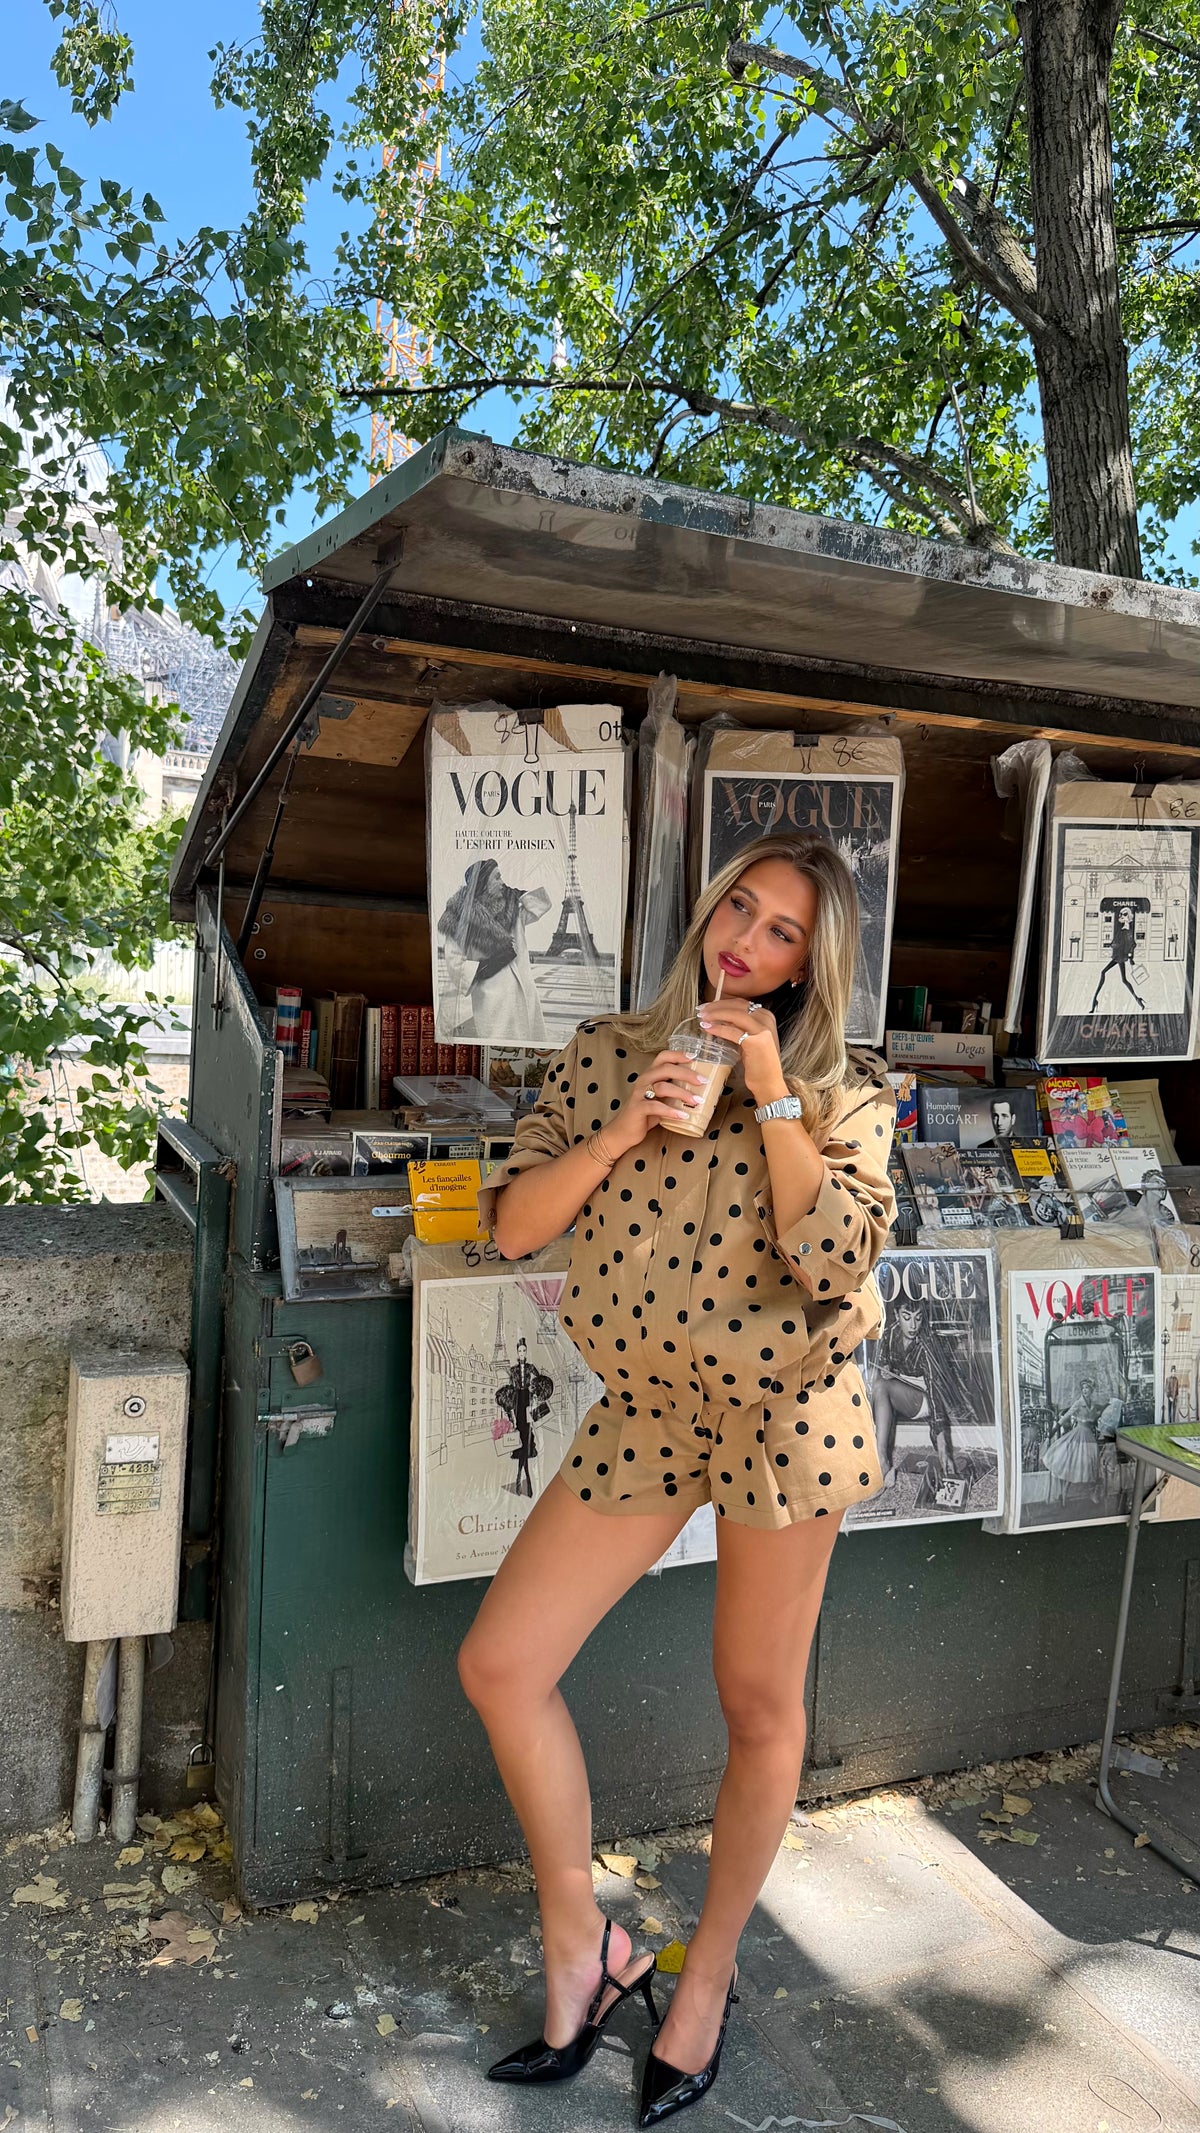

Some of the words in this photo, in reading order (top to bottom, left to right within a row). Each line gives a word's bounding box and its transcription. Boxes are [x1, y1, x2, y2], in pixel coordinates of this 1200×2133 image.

[832, 736, 867, 768] 8€
[446, 769, 606, 818] VOGUE
[483, 790, 501, 798] PARIS
[719, 783, 882, 830] VOGUE
[758, 801, 776, 809] PARIS
[481, 830, 513, 838] COUTURE
[455, 839, 504, 850] L'ESPRIT
[507, 839, 556, 850] PARISIEN
[1080, 1021, 1160, 1039] CHANEL
[891, 1042, 899, 1051] DE
[900, 1043, 915, 1052] L'ART
[955, 1041, 986, 1059] Degas
[926, 1102, 961, 1112] Humphrey
[927, 1113, 979, 1125] BOGART
[1097, 1153, 1110, 1163] 3€
[422, 1175, 435, 1183] Les
[436, 1174, 472, 1185] fiançailles
[429, 1183, 467, 1193] d'Imogène
[874, 1260, 977, 1302] OGUE
[1024, 1277, 1148, 1322] VOGUE
[1068, 1327, 1099, 1337] LOUVRE
[470, 1549, 499, 1559] Avenue
